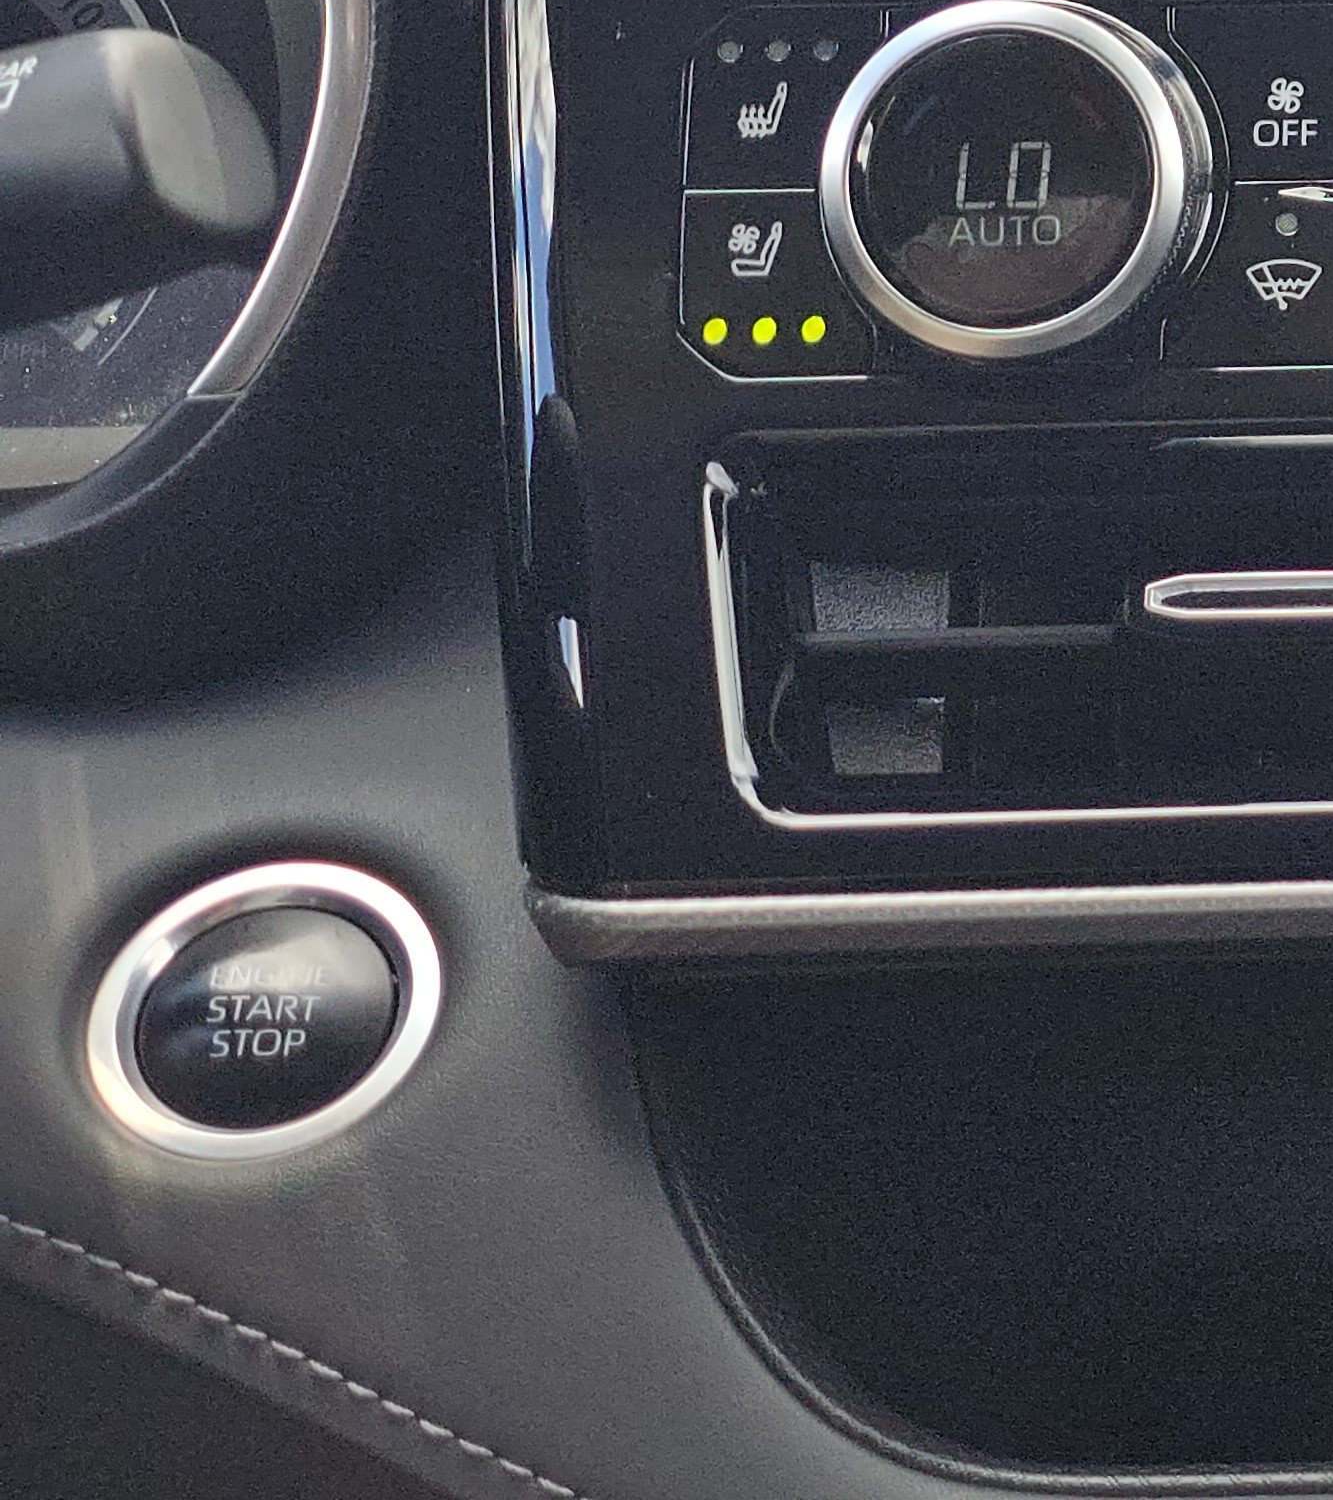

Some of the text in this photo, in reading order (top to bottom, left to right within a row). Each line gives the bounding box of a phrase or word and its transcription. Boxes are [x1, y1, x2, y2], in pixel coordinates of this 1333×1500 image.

[1253, 119, 1318, 146] OFF
[948, 212, 1061, 246] AUTO
[206, 994, 321, 1023] START
[209, 1028, 306, 1058] STOP
